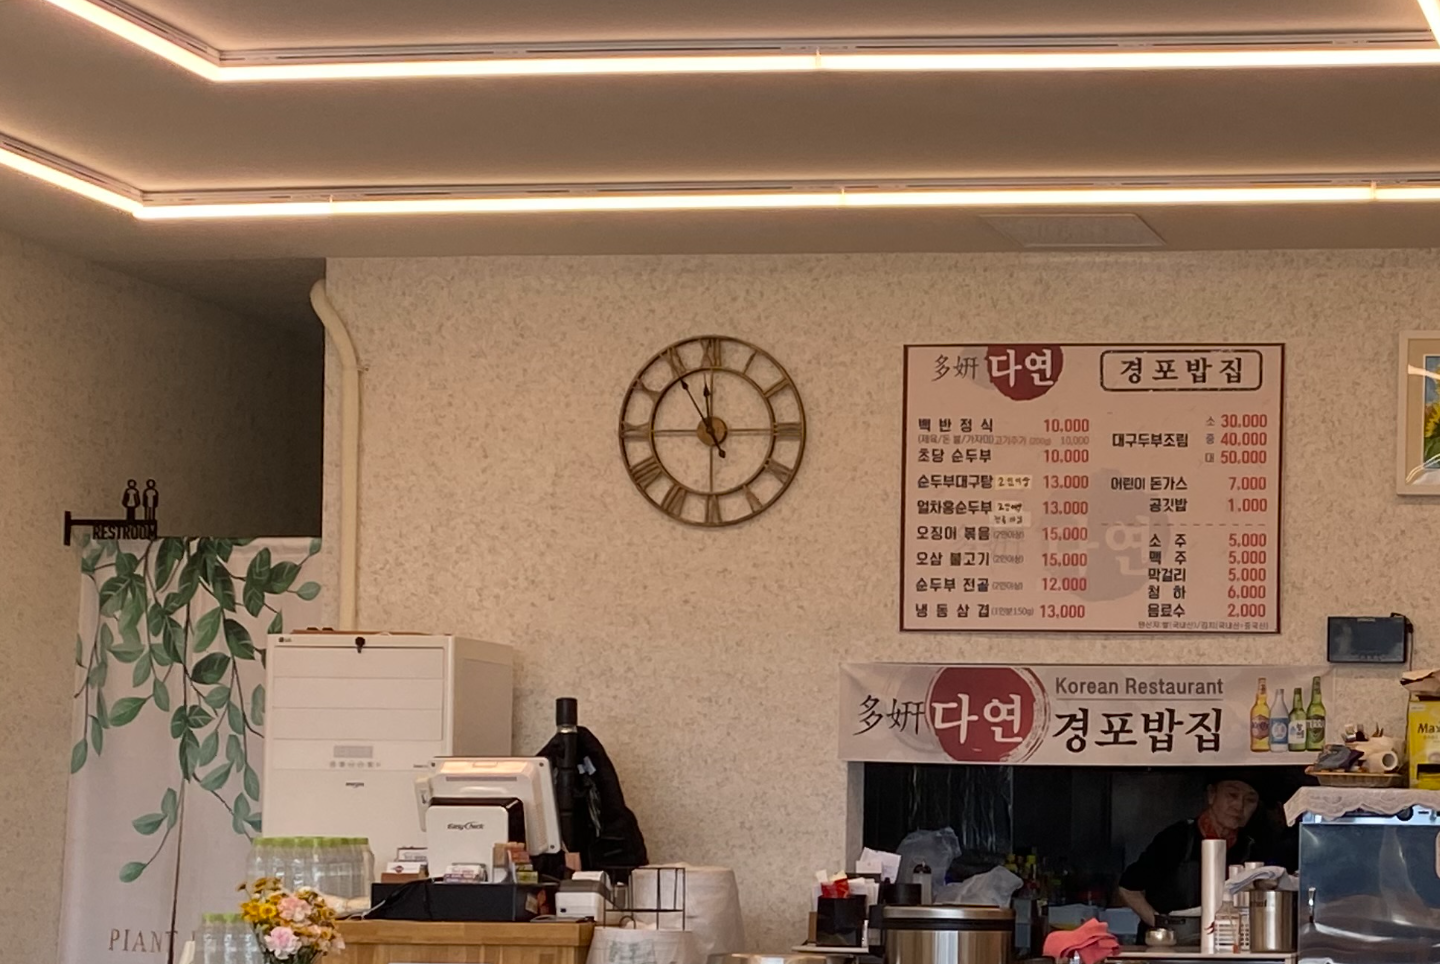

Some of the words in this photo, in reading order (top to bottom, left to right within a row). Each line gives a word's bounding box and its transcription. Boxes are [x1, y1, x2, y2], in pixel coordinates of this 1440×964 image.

[988, 349, 1054, 388] 다연
[1120, 357, 1242, 384] 경포밥집
[1206, 416, 1215, 426] 소
[1112, 433, 1189, 448] 대구두부조림
[1205, 433, 1215, 445] 중
[918, 448, 944, 463] 초당
[951, 448, 992, 463] 순두부
[1205, 452, 1215, 463] 대
[917, 474, 994, 489] 순두부대구탕
[1111, 477, 1145, 491] 어린이
[1150, 477, 1188, 491] 돈가스
[1150, 498, 1187, 513] 공깃밥
[92, 525, 157, 540] RESTROOM
[916, 526, 957, 541] 오징어
[964, 526, 990, 541] 볶음
[916, 552, 943, 567] 오삼
[949, 552, 990, 567] 불고기
[1148, 568, 1187, 582] 막걸리
[916, 578, 956, 592] 순두부
[963, 578, 989, 592] 전골
[1148, 603, 1185, 618] 음료수
[1056, 677, 1118, 695] Korean
[1125, 677, 1224, 695] Restaurant
[931, 694, 1023, 743] 다연
[1052, 707, 1223, 753] 경포밥집
